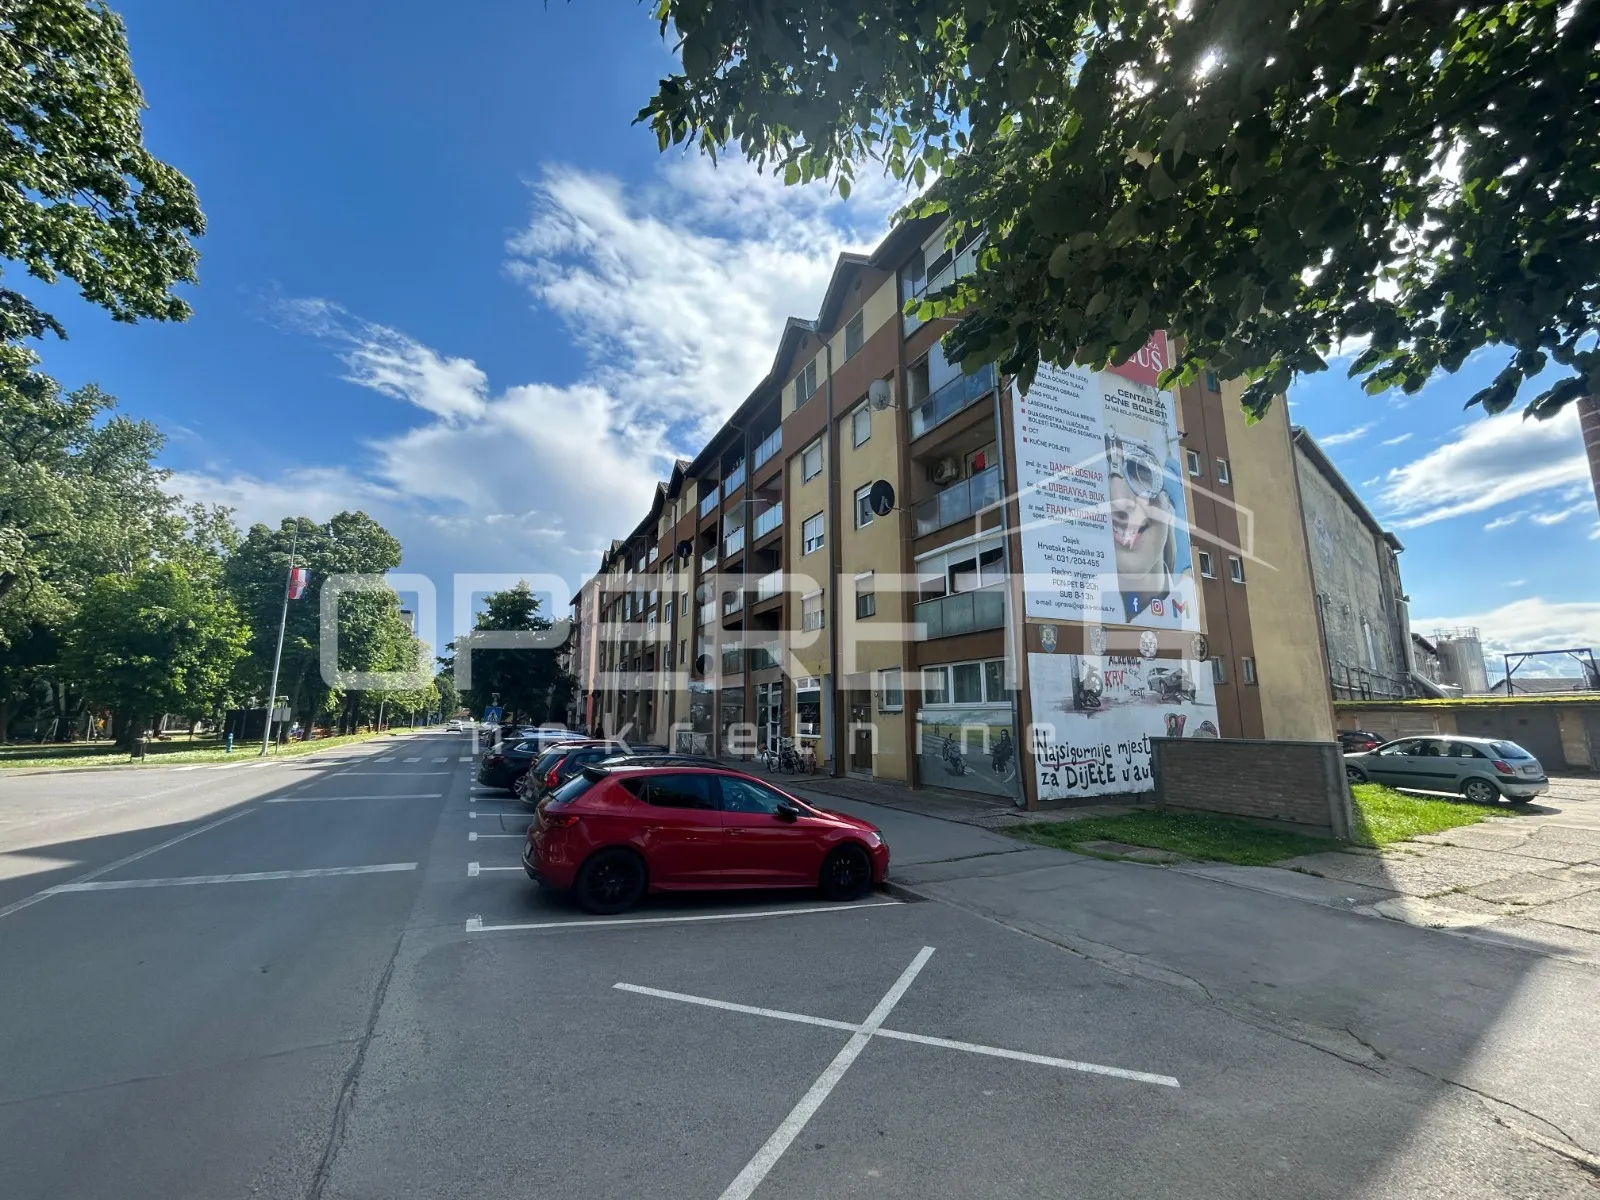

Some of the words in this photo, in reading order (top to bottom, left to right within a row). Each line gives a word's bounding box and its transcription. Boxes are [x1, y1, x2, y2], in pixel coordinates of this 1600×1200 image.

[1118, 389, 1153, 405] CENTAR
[1155, 400, 1166, 410] ZA
[1028, 399, 1053, 411] LASERSKA
[1054, 406, 1079, 418] OPERACIJA
[1132, 403, 1167, 419] BOLESTI
[1028, 417, 1049, 427] BOLESTI
[1078, 430, 1102, 440] SEGMENTA
[1076, 468, 1103, 482] BOSNAR
[1049, 482, 1087, 498] DUBRAVKA
[1046, 503, 1066, 514] FRAN
[1063, 536, 1080, 545] Osijek
[1038, 542, 1065, 552] Hrvatske
[1067, 546, 1094, 557] Republike
[1056, 555, 1100, 567] 031/204-455
[1104, 670, 1124, 688] KRV
[1036, 728, 1112, 771] Najsigurnije
[1118, 733, 1152, 764] mjest
[1041, 772, 1059, 787] za
[1122, 768, 1129, 781] u
